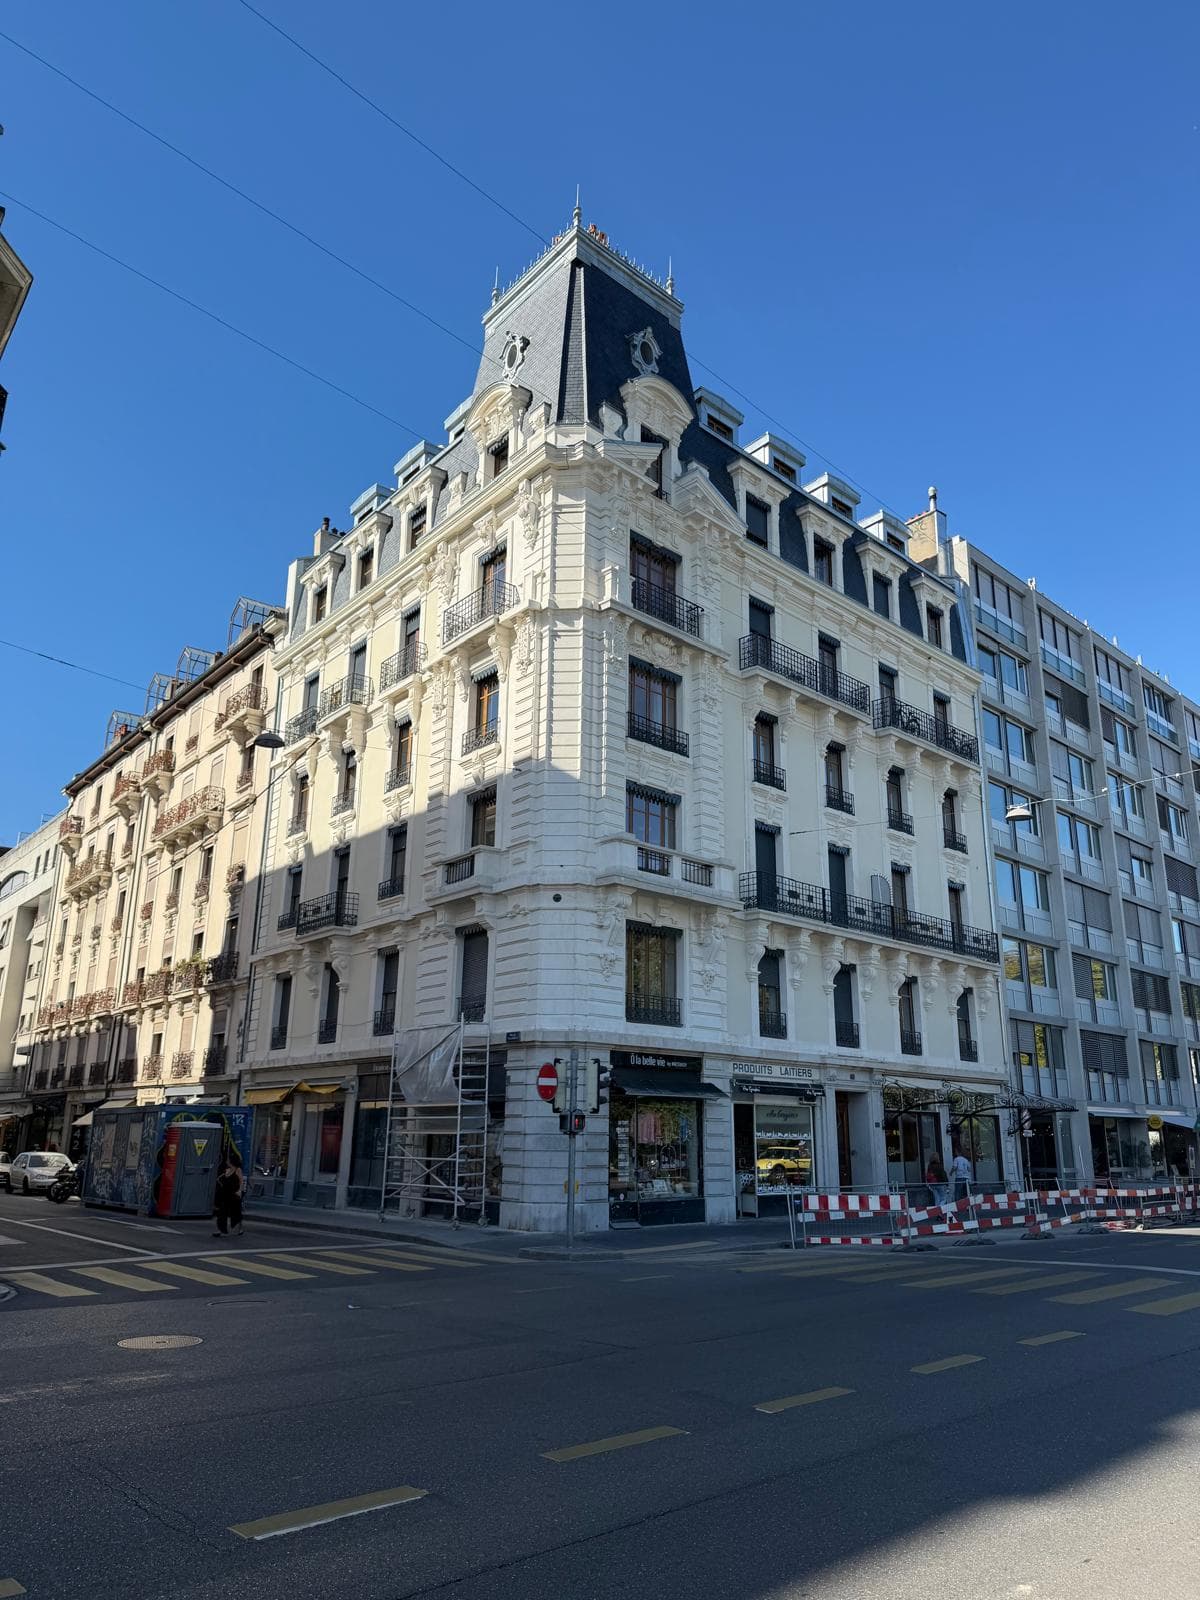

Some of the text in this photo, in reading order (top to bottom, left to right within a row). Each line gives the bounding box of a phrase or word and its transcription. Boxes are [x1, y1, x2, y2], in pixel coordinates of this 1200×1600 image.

[636, 1055, 642, 1066] la
[642, 1055, 657, 1067] belle
[657, 1057, 666, 1067] vie
[732, 1063, 813, 1078] PRODUITS LAITIERS
